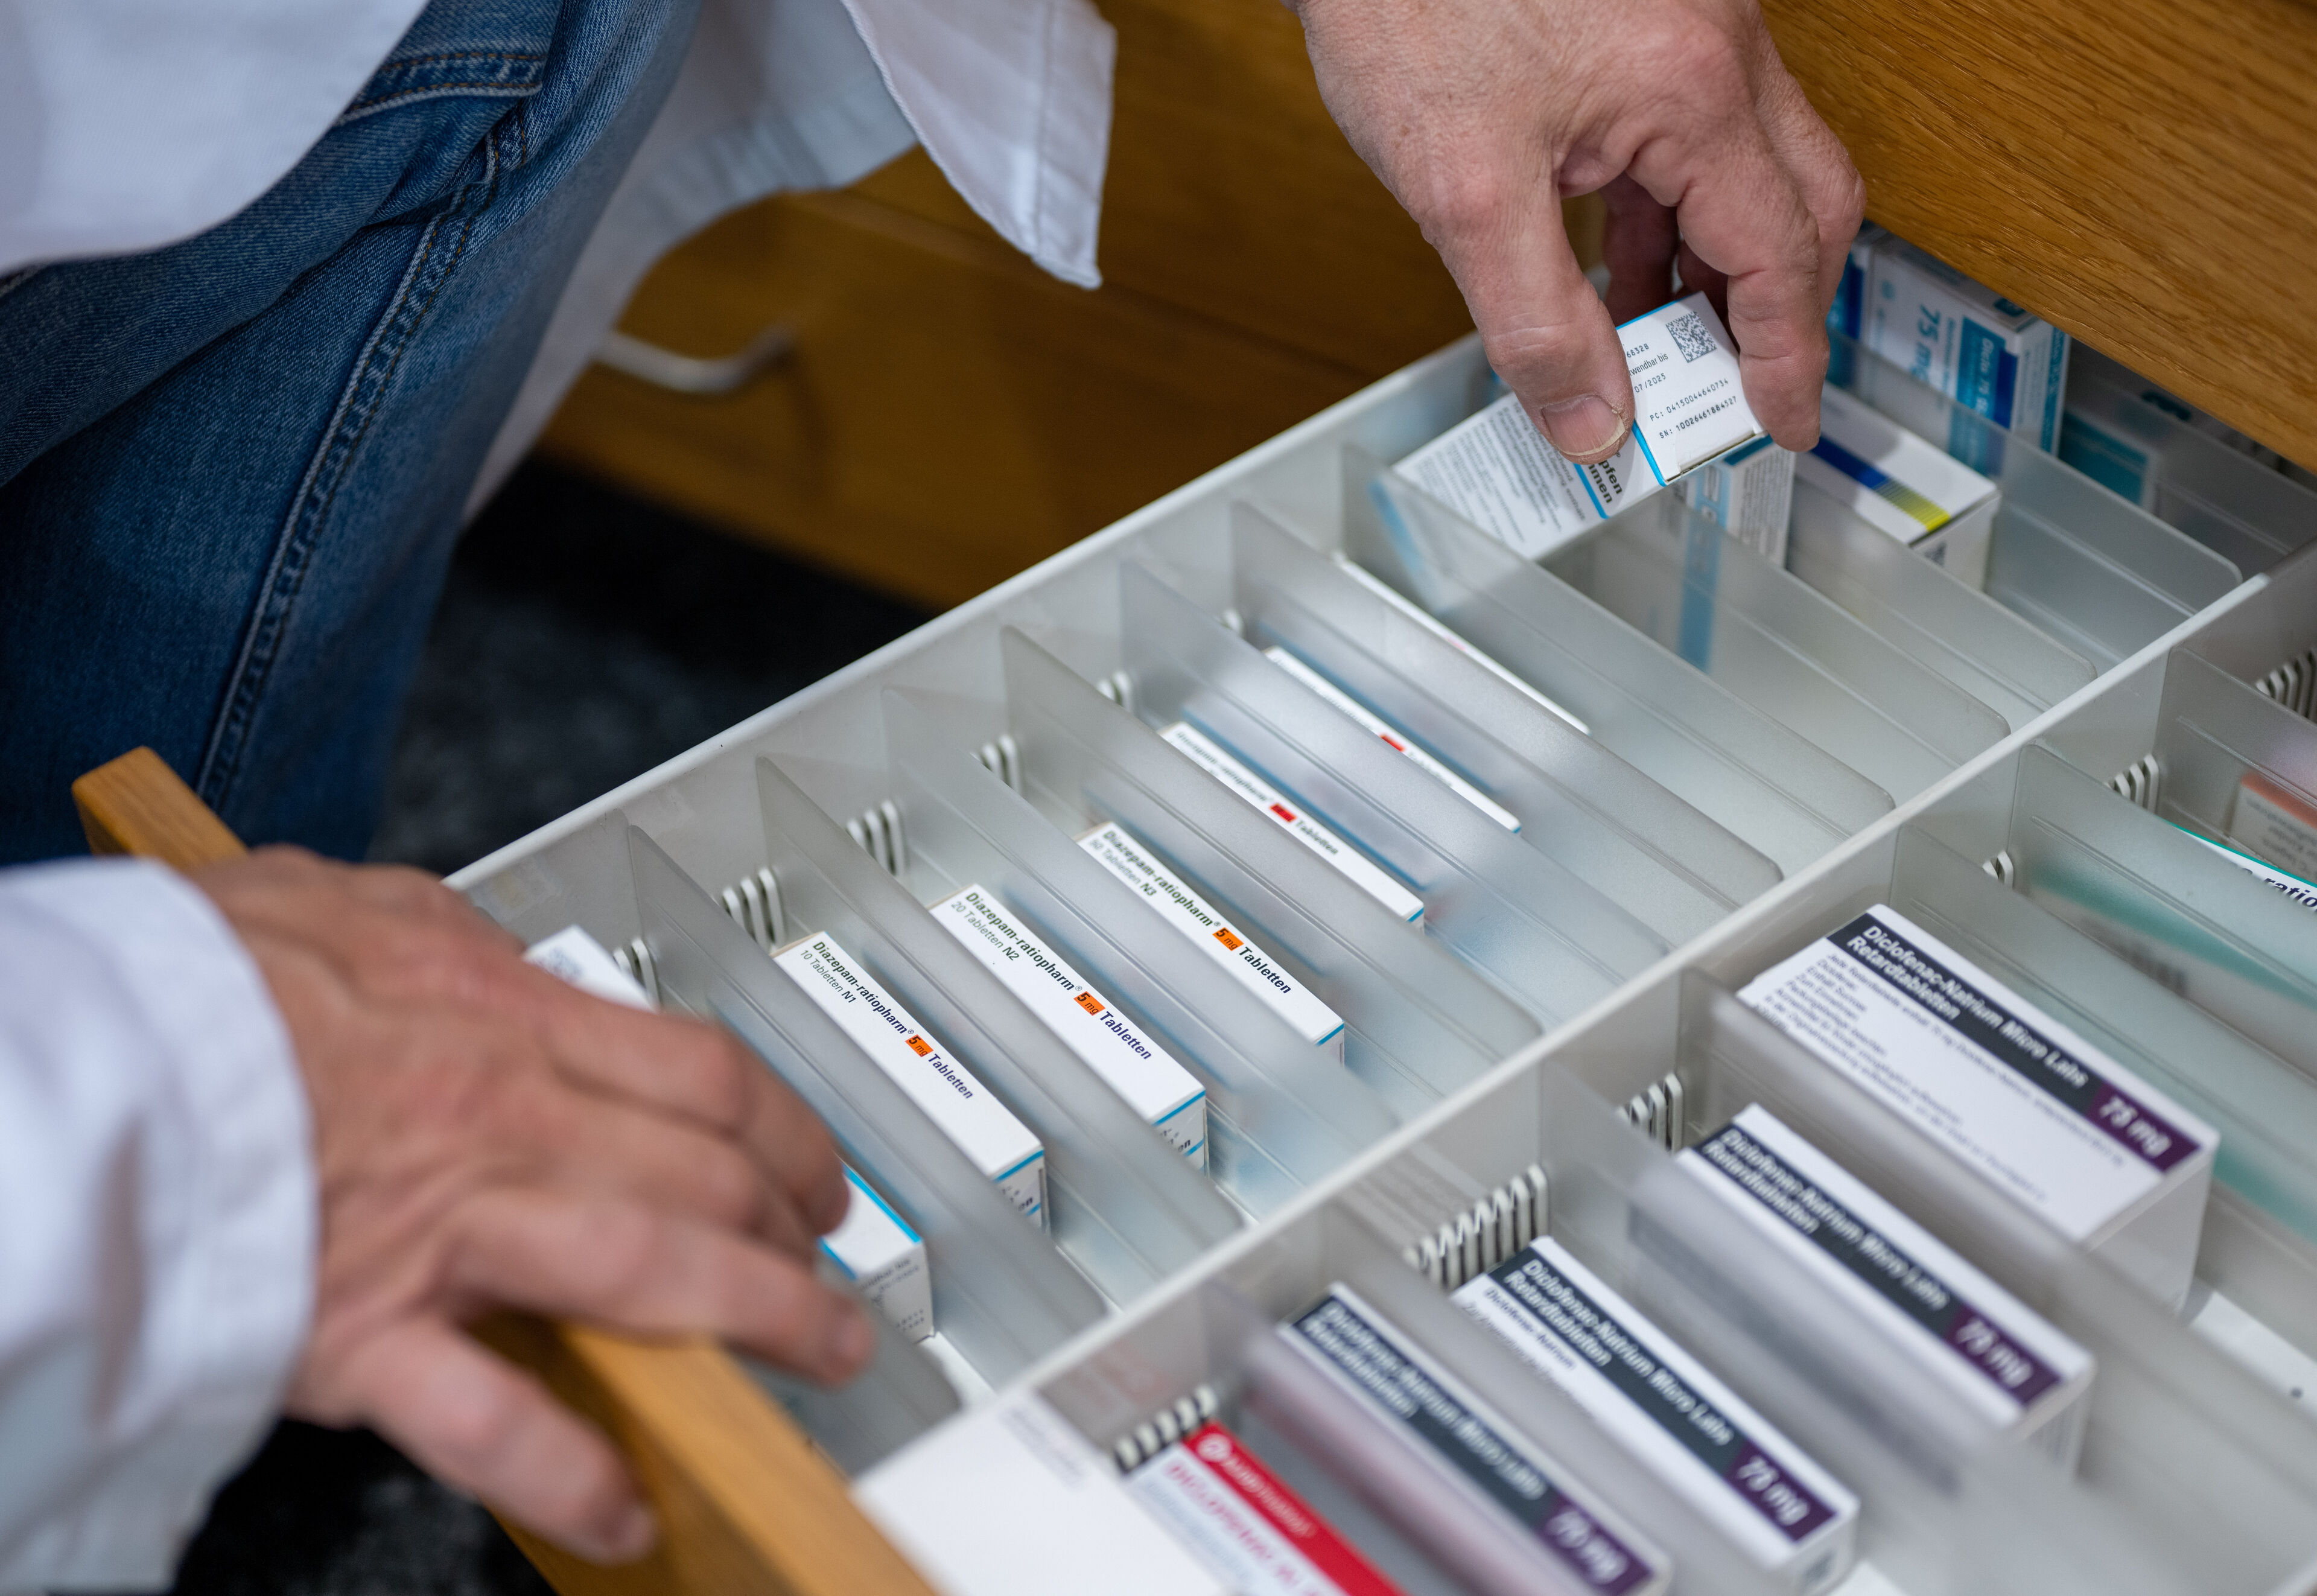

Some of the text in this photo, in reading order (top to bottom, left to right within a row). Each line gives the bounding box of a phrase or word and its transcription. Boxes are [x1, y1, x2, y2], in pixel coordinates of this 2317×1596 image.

[1629, 352, 1669, 377] rwendbar bis
[1634, 372, 1667, 393] 07/2025
[1649, 411, 1664, 422] PC:
[1659, 428, 1673, 439] SN:
[1598, 460, 1623, 495] pfen
[1102, 848, 1142, 885] Tabletten
[1139, 882, 1158, 897] N3
[951, 900, 1020, 961] 20 Tabletten N2
[1215, 928, 1229, 938] 5
[1223, 937, 1238, 951] mg
[1239, 946, 1292, 994] Tabletten
[800, 949, 857, 1003] 10 Tabletten N1
[1846, 935, 1962, 1021] Retardtabletten
[1076, 991, 1091, 1002] 5
[1084, 1002, 1099, 1016] mg
[1099, 1010, 1152, 1060] Tabletten
[1862, 925, 2090, 1090] Diclofenac-Natrium Micro Labs
[908, 1035, 921, 1044] 5
[915, 1044, 929, 1057] mg
[927, 1053, 974, 1099] Tabletten
[2099, 1095, 2173, 1159] 75 mg
[1521, 1258, 1656, 1378] Diclofenac-Natrium
[1737, 1454, 1810, 1527] 75 mg
